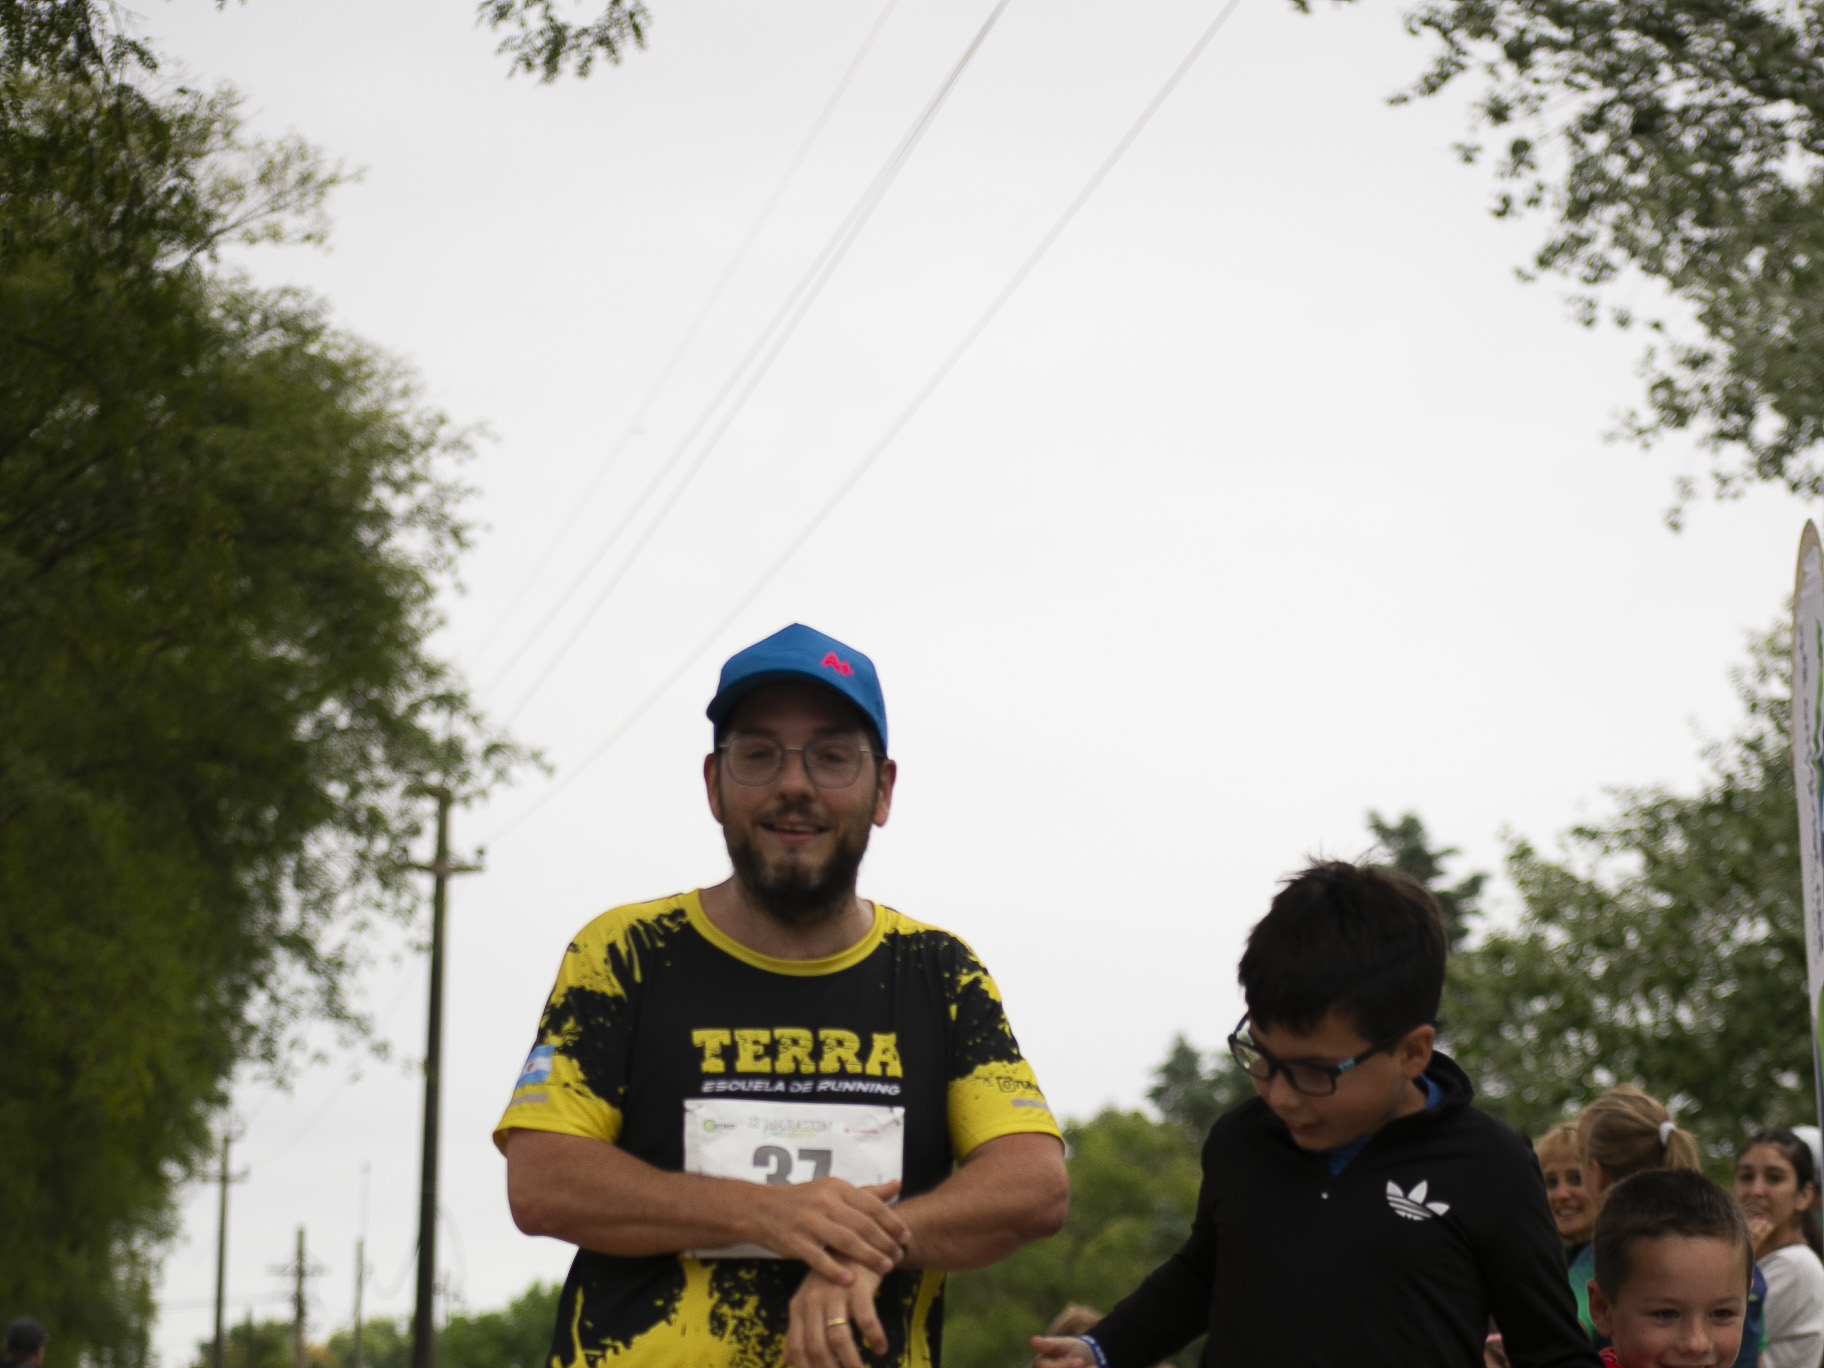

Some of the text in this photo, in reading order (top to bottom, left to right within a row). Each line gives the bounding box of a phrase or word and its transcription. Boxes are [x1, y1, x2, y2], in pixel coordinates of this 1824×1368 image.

[691, 1028, 903, 1079] TERRA
[701, 1079, 902, 1096] ESCUELA DE RUNNING
[752, 1145, 833, 1186] 37
